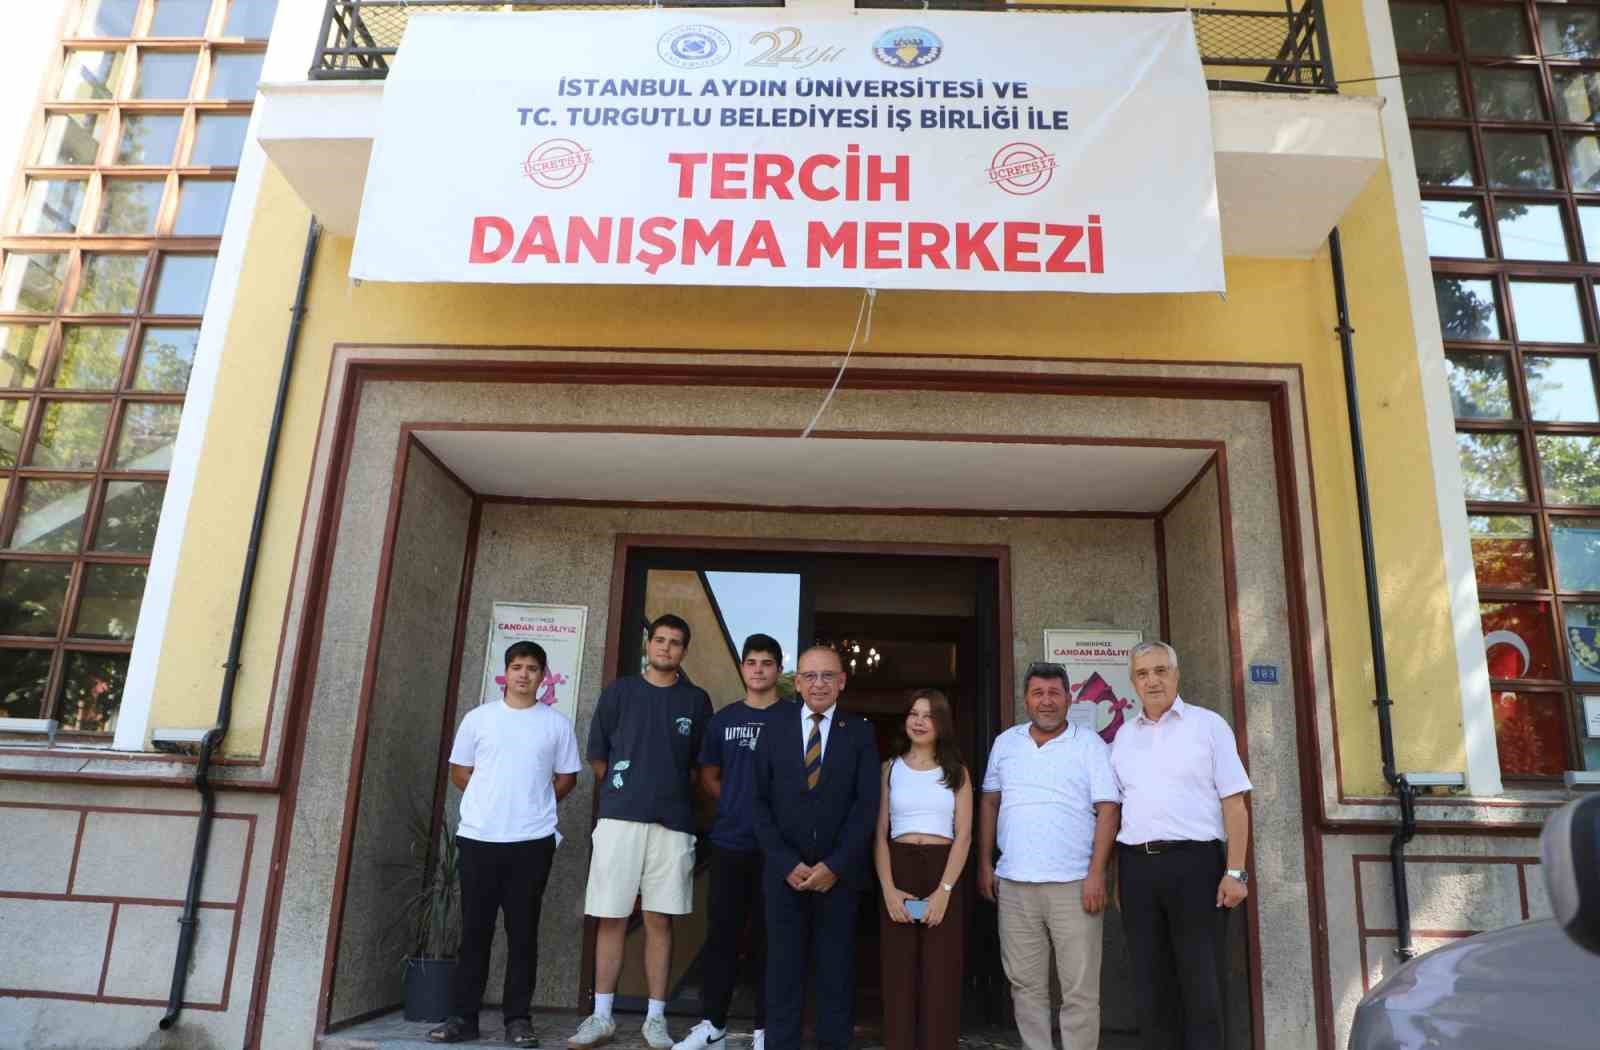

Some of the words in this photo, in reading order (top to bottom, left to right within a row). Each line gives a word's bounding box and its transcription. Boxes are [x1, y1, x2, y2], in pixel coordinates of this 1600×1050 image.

[559, 76, 691, 97] İSTANBUL
[700, 79, 787, 97] AYDIN
[796, 76, 984, 98] ÜNİVERSİTESİ
[992, 81, 1026, 98] VE
[518, 108, 557, 126] TC.
[568, 109, 711, 126] TURGUTLU
[721, 104, 878, 128] BELEDİYESİ
[888, 104, 912, 132] İŞ
[921, 106, 1018, 129] BİRLİĞİ
[1028, 107, 1068, 130] İLE
[668, 143, 910, 201] TERCİH
[988, 157, 1057, 181] ÜCRETSİZ
[469, 216, 786, 274] DANIŞMA
[807, 214, 1104, 273] MERKEZİ
[498, 623, 534, 632] CANDAN
[1055, 649, 1093, 657] CANDAN
